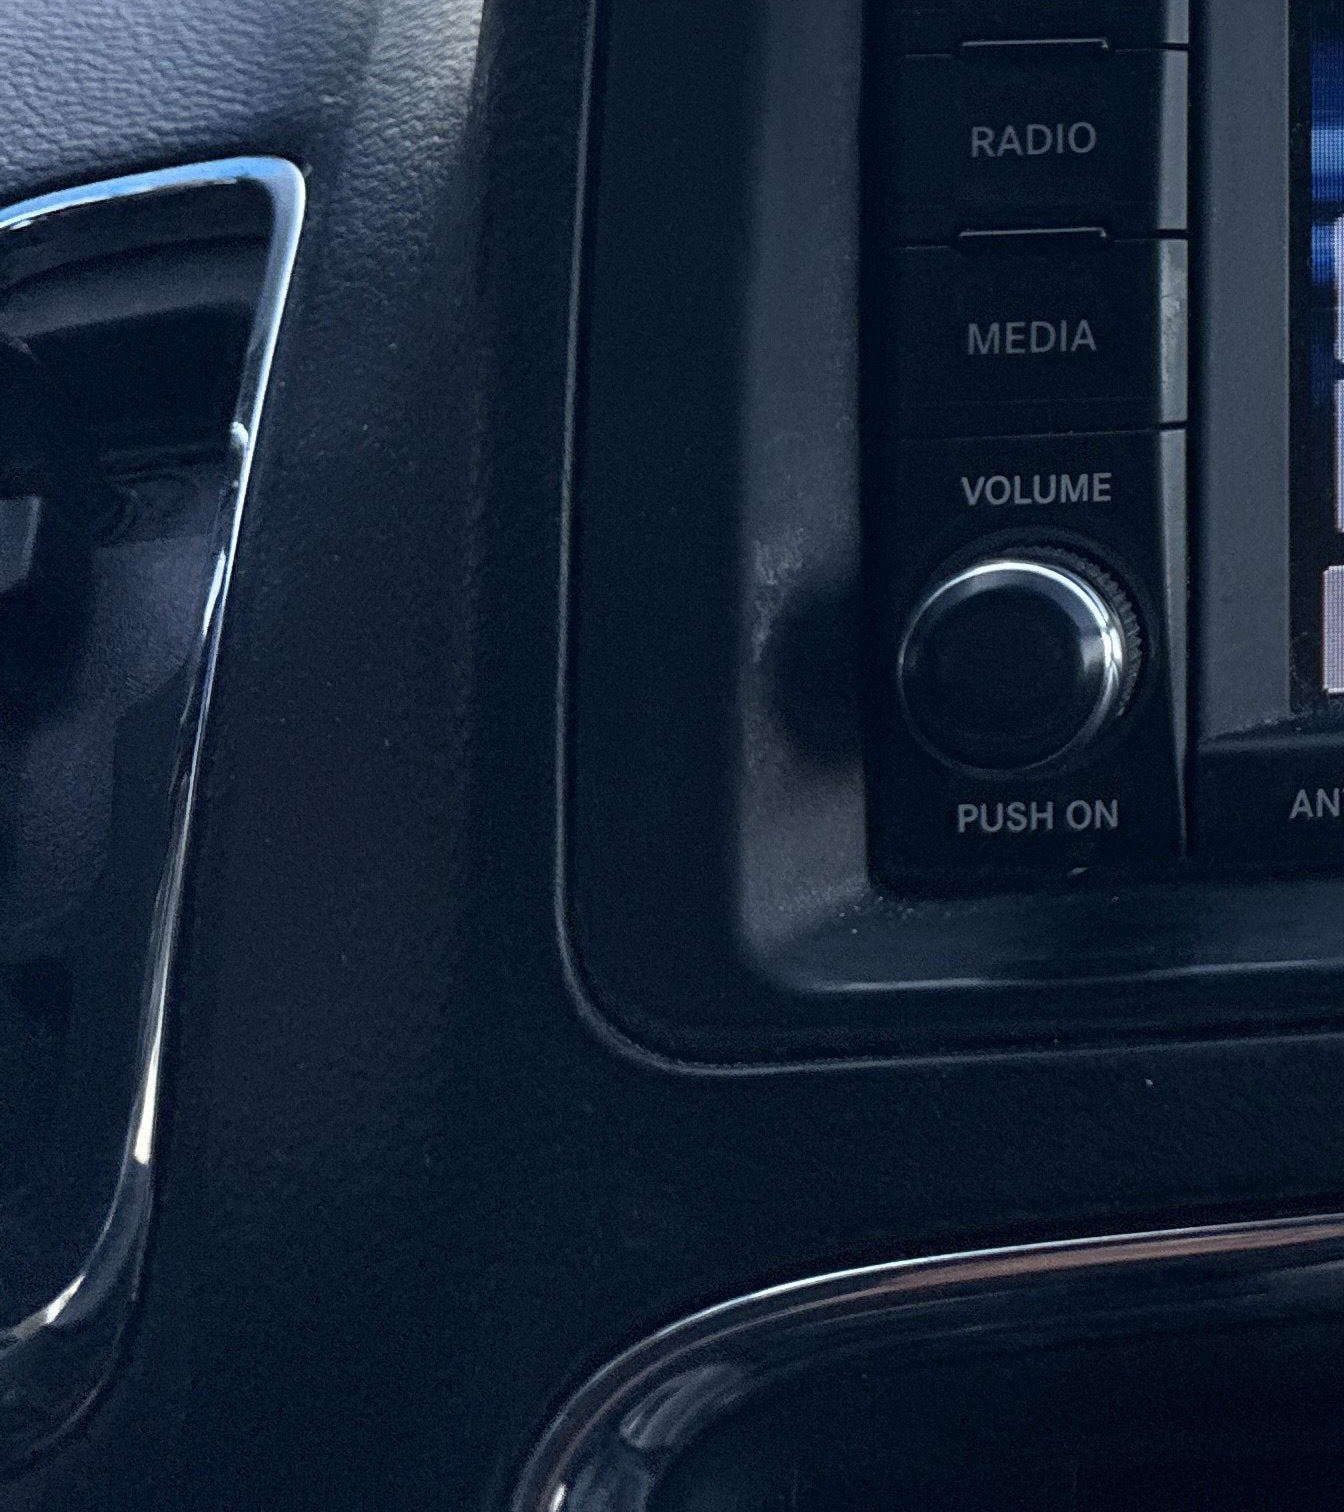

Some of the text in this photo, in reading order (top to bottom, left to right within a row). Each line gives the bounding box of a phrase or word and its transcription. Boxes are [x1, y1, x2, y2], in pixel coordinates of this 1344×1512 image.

[971, 121, 1097, 157] RADIO
[967, 320, 1097, 356] MEDIA
[961, 472, 1113, 506] VOLUME
[957, 798, 1120, 834] PUSH ON
